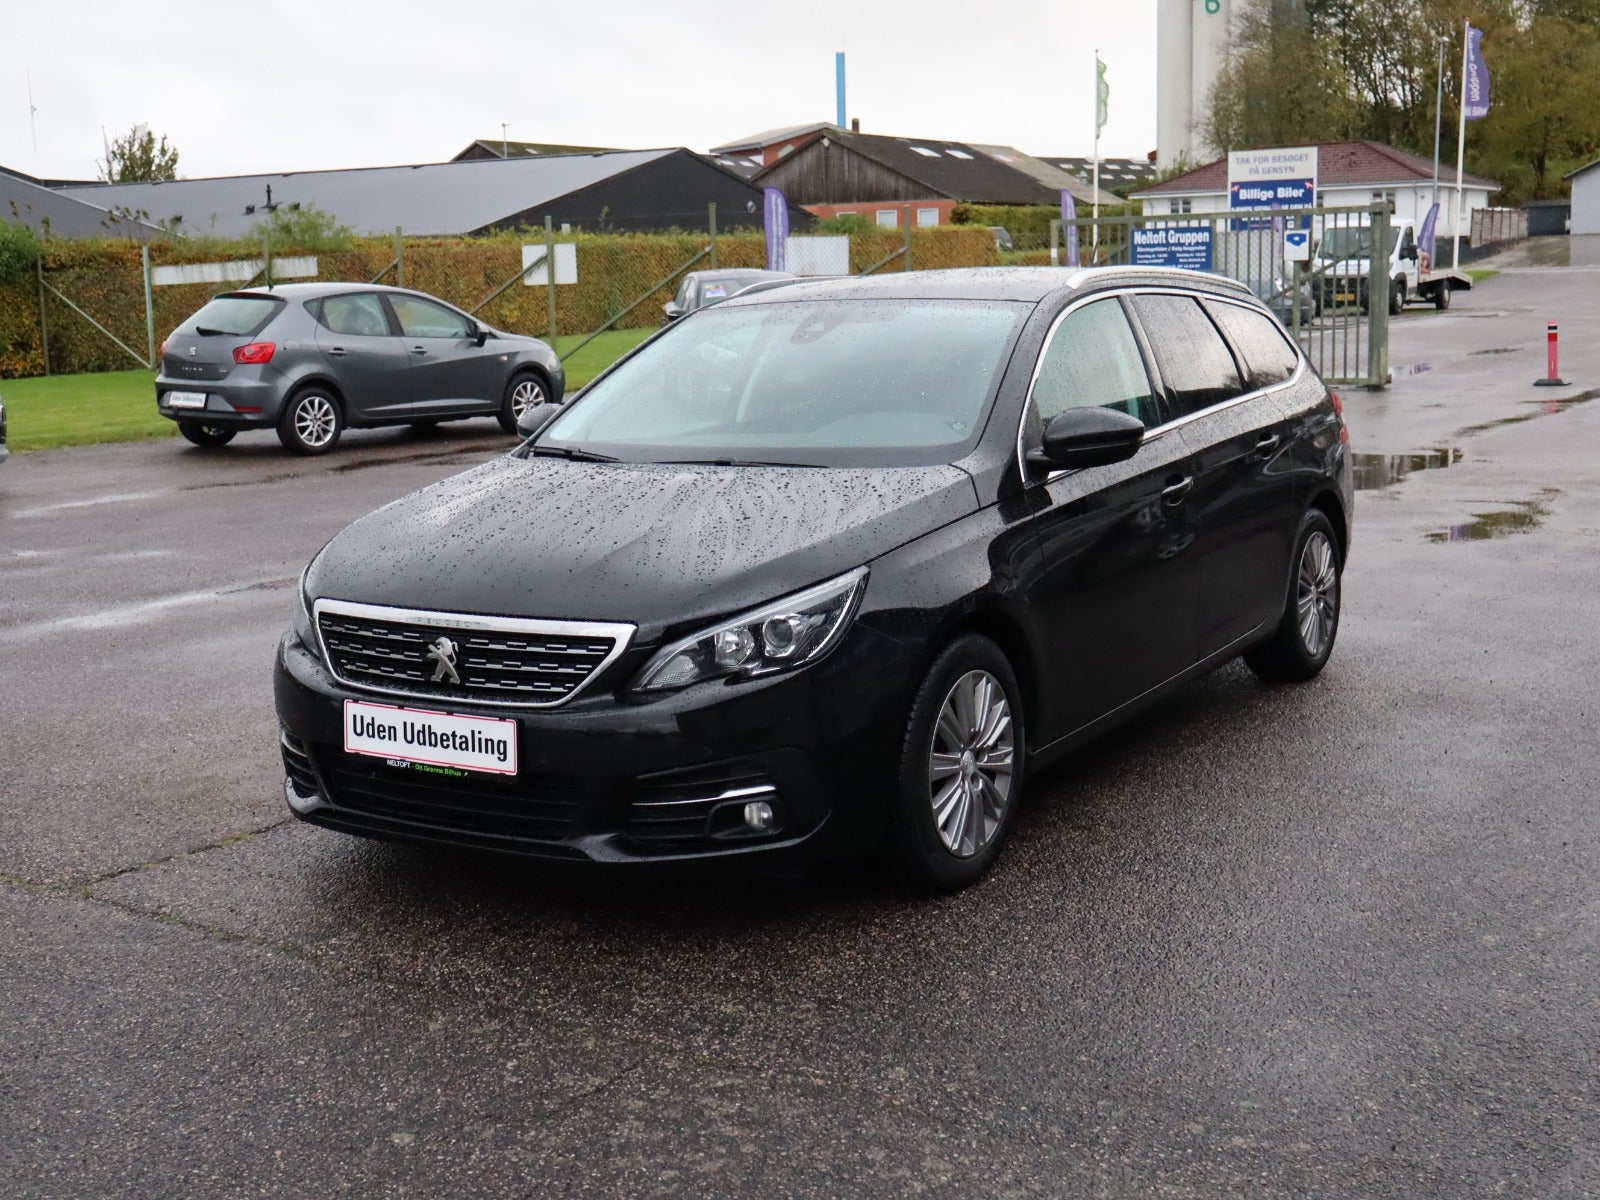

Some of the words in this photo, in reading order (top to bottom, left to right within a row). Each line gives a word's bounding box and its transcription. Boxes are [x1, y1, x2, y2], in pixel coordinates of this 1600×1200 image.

[1469, 63, 1480, 102] Gruppen
[1236, 157, 1251, 165] TAK
[1253, 156, 1270, 164] FOR
[1271, 154, 1309, 163] BESØGET
[1248, 166, 1260, 175] PÅ
[1262, 166, 1296, 175] GENSYN
[1239, 188, 1275, 201] Billige
[1276, 187, 1305, 198] Biler
[1134, 230, 1167, 245] Neltoft
[1167, 229, 1210, 245] Gruppen
[416, 615, 481, 628] PEUGEOT
[352, 713, 397, 742] Uden
[403, 721, 508, 763] Udbetaling
[387, 759, 411, 769] NELTOFT
